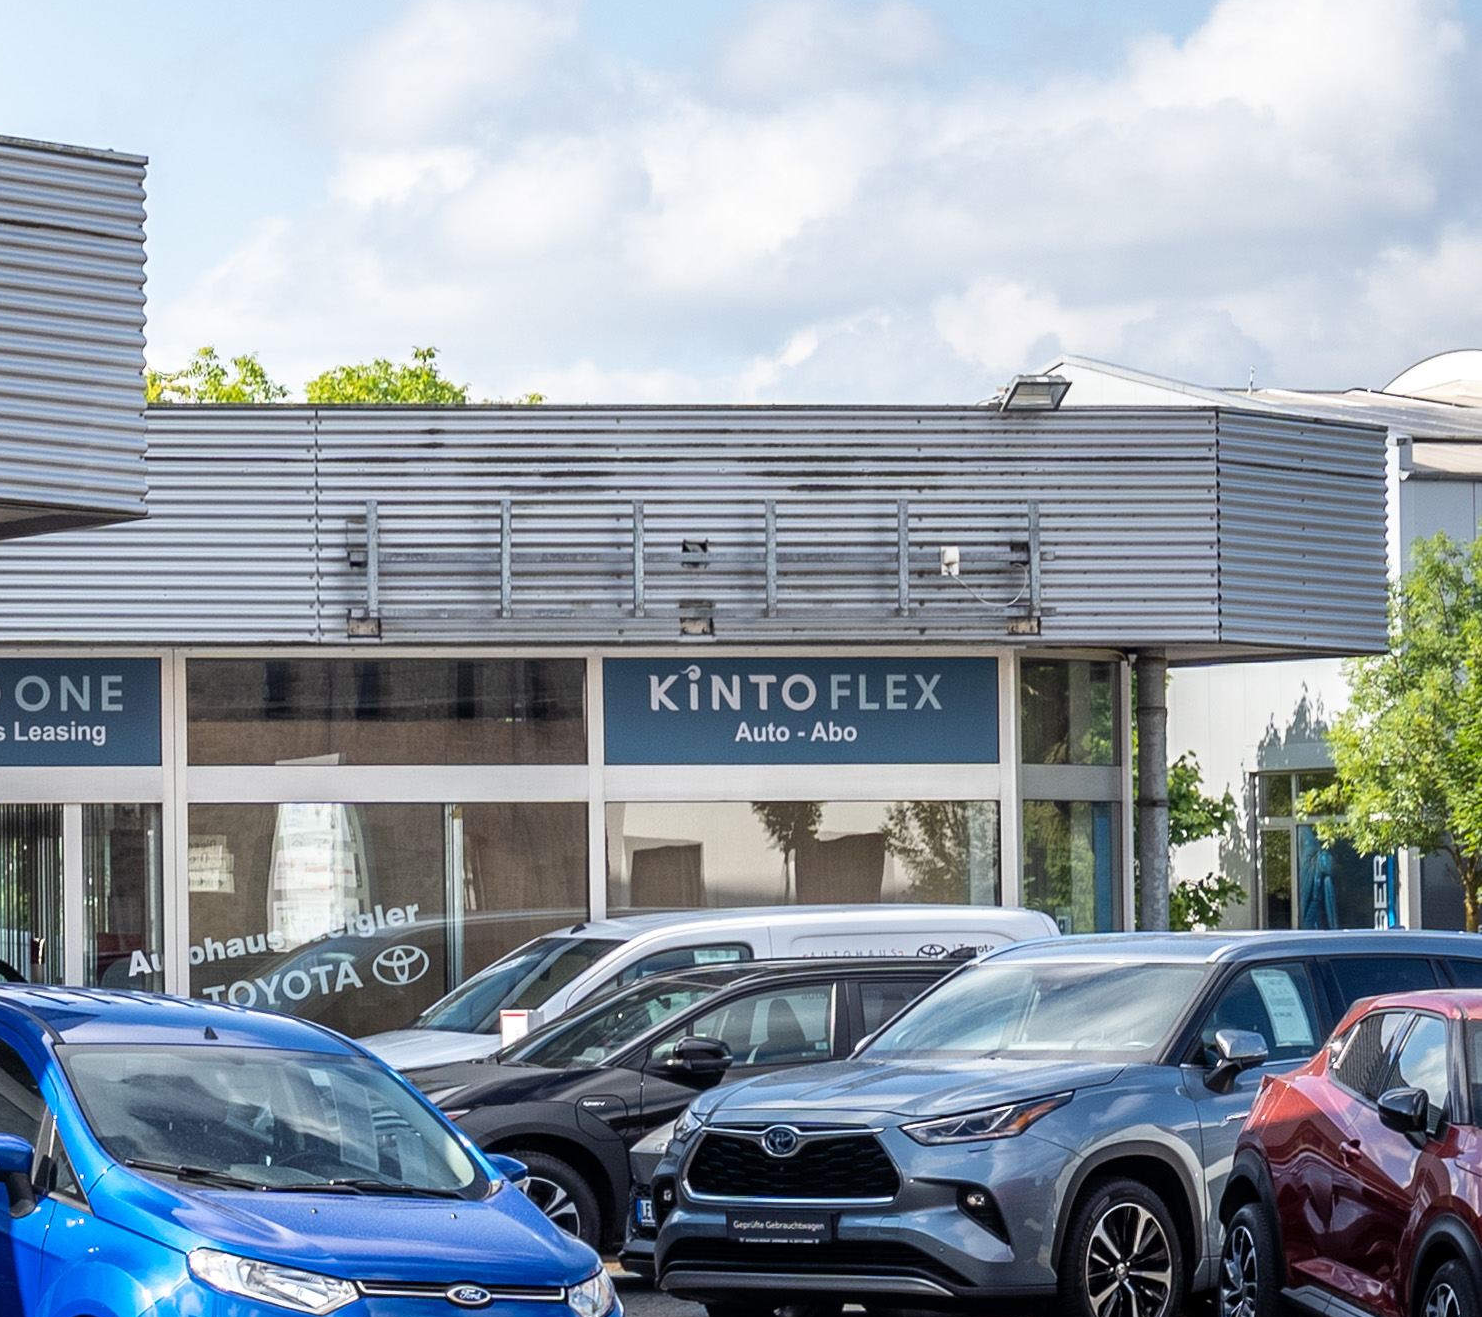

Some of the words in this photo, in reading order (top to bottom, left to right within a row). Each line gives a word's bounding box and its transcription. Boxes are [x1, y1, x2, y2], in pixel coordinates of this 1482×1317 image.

[15, 675, 123, 712] ONE
[830, 673, 944, 712] FLEX
[14, 721, 106, 746] Leasing
[735, 721, 791, 743] Auto
[811, 720, 859, 743] Abo
[128, 930, 287, 977] Auohaus
[202, 959, 364, 1008] TOYOTA
[733, 1219, 765, 1230] Geprüfte
[765, 1219, 825, 1231] Gebrauchtwagen
[459, 1289, 482, 1300] Ford
